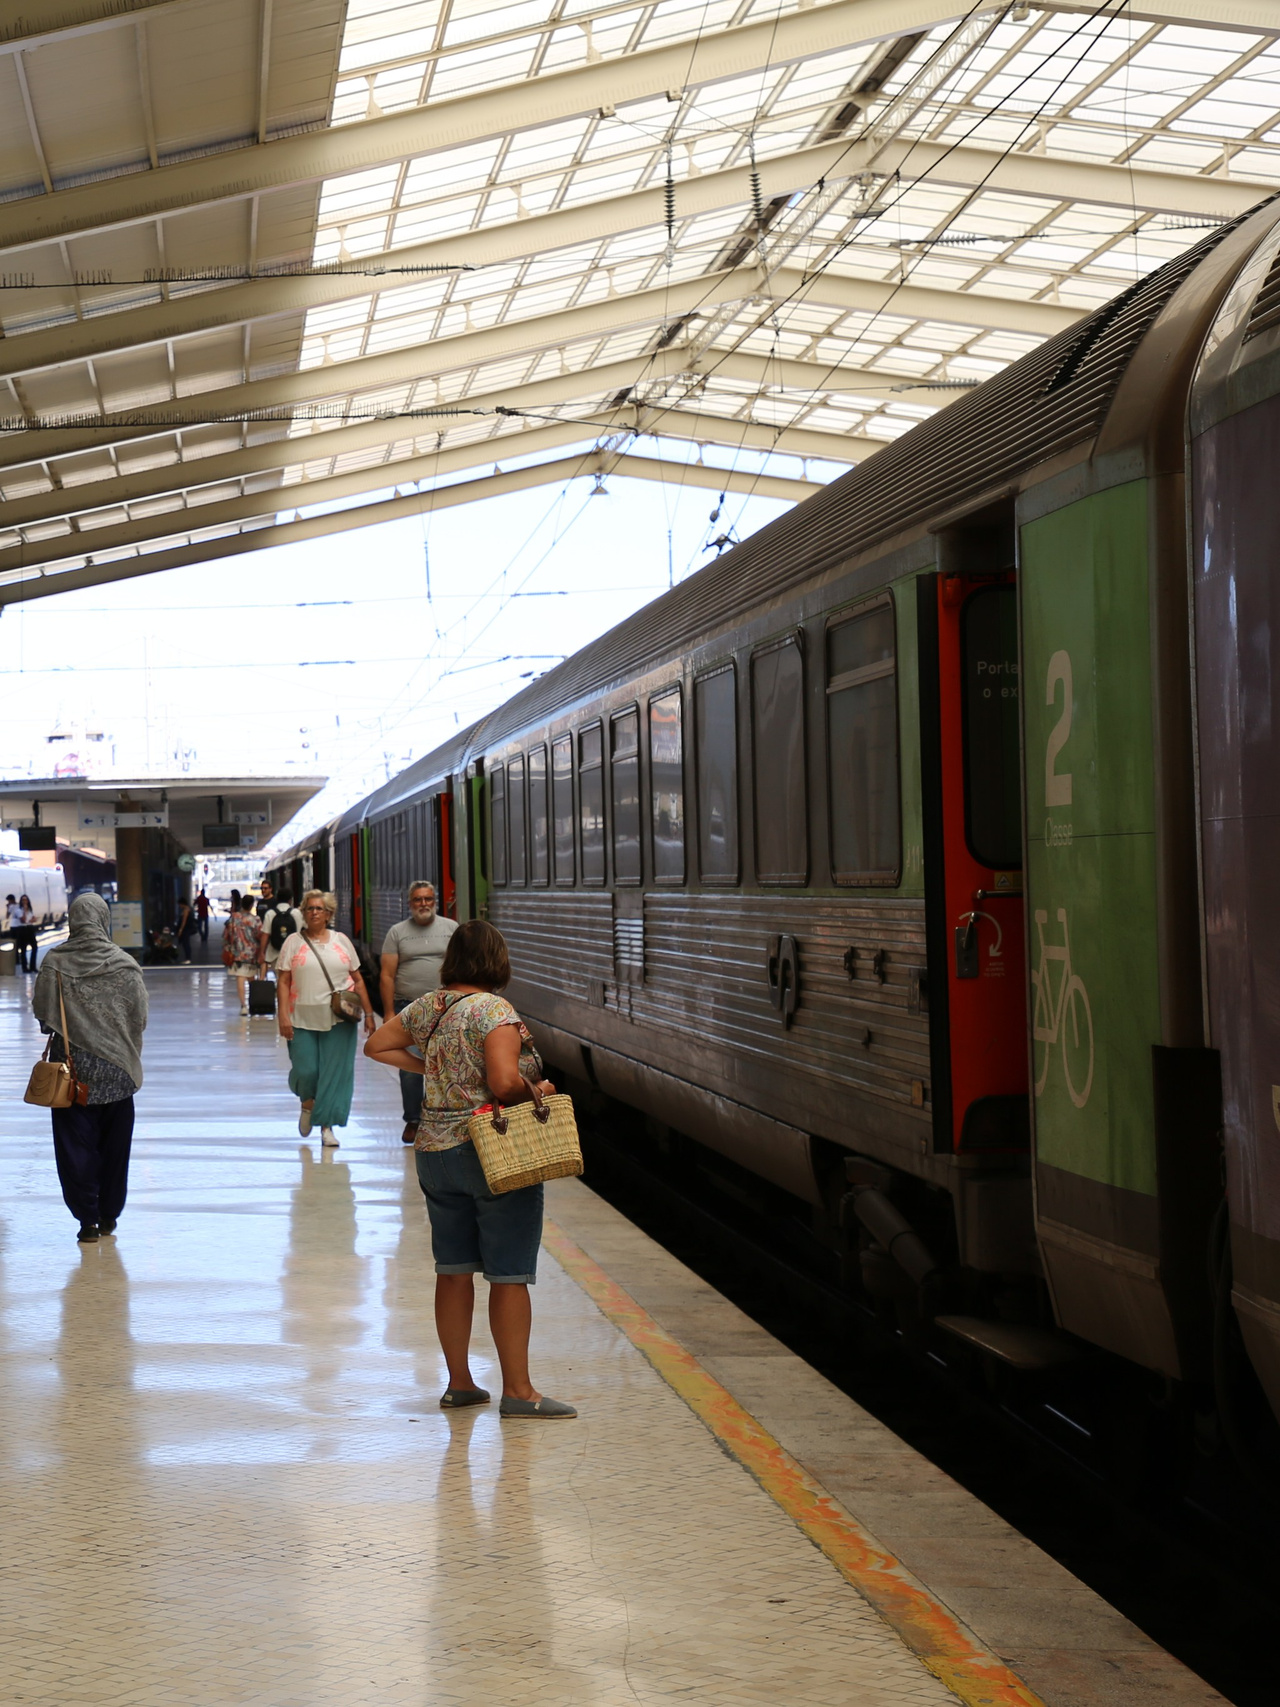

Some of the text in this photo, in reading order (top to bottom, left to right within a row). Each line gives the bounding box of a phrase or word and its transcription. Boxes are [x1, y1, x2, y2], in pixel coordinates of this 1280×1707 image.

[983, 688, 991, 698] o
[1045, 650, 1073, 807] 2
[1045, 817, 1073, 847] Classe
